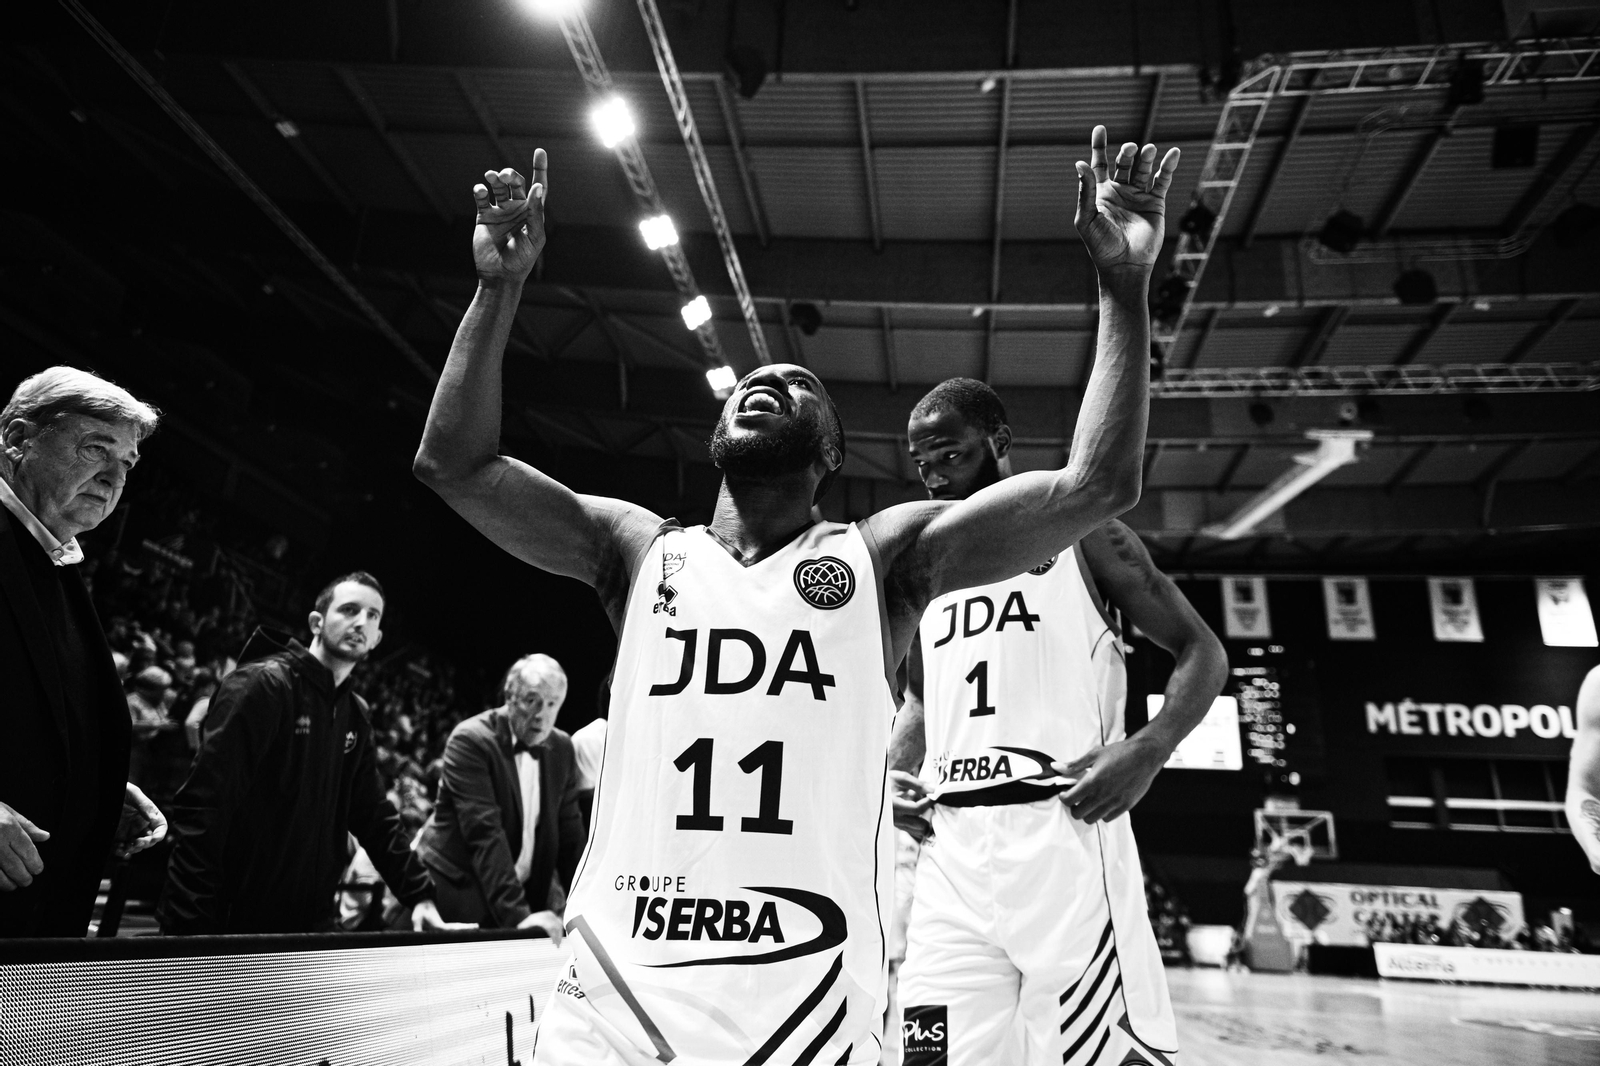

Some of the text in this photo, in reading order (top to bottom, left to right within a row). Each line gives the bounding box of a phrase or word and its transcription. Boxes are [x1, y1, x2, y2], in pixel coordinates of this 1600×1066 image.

[934, 591, 1040, 649] JDA
[649, 627, 836, 701] JDA
[965, 660, 996, 718] 1
[673, 737, 794, 835] 11
[614, 875, 686, 893] GROUPE
[1350, 889, 1441, 909] OPTICAL
[632, 896, 785, 944] ISERBA
